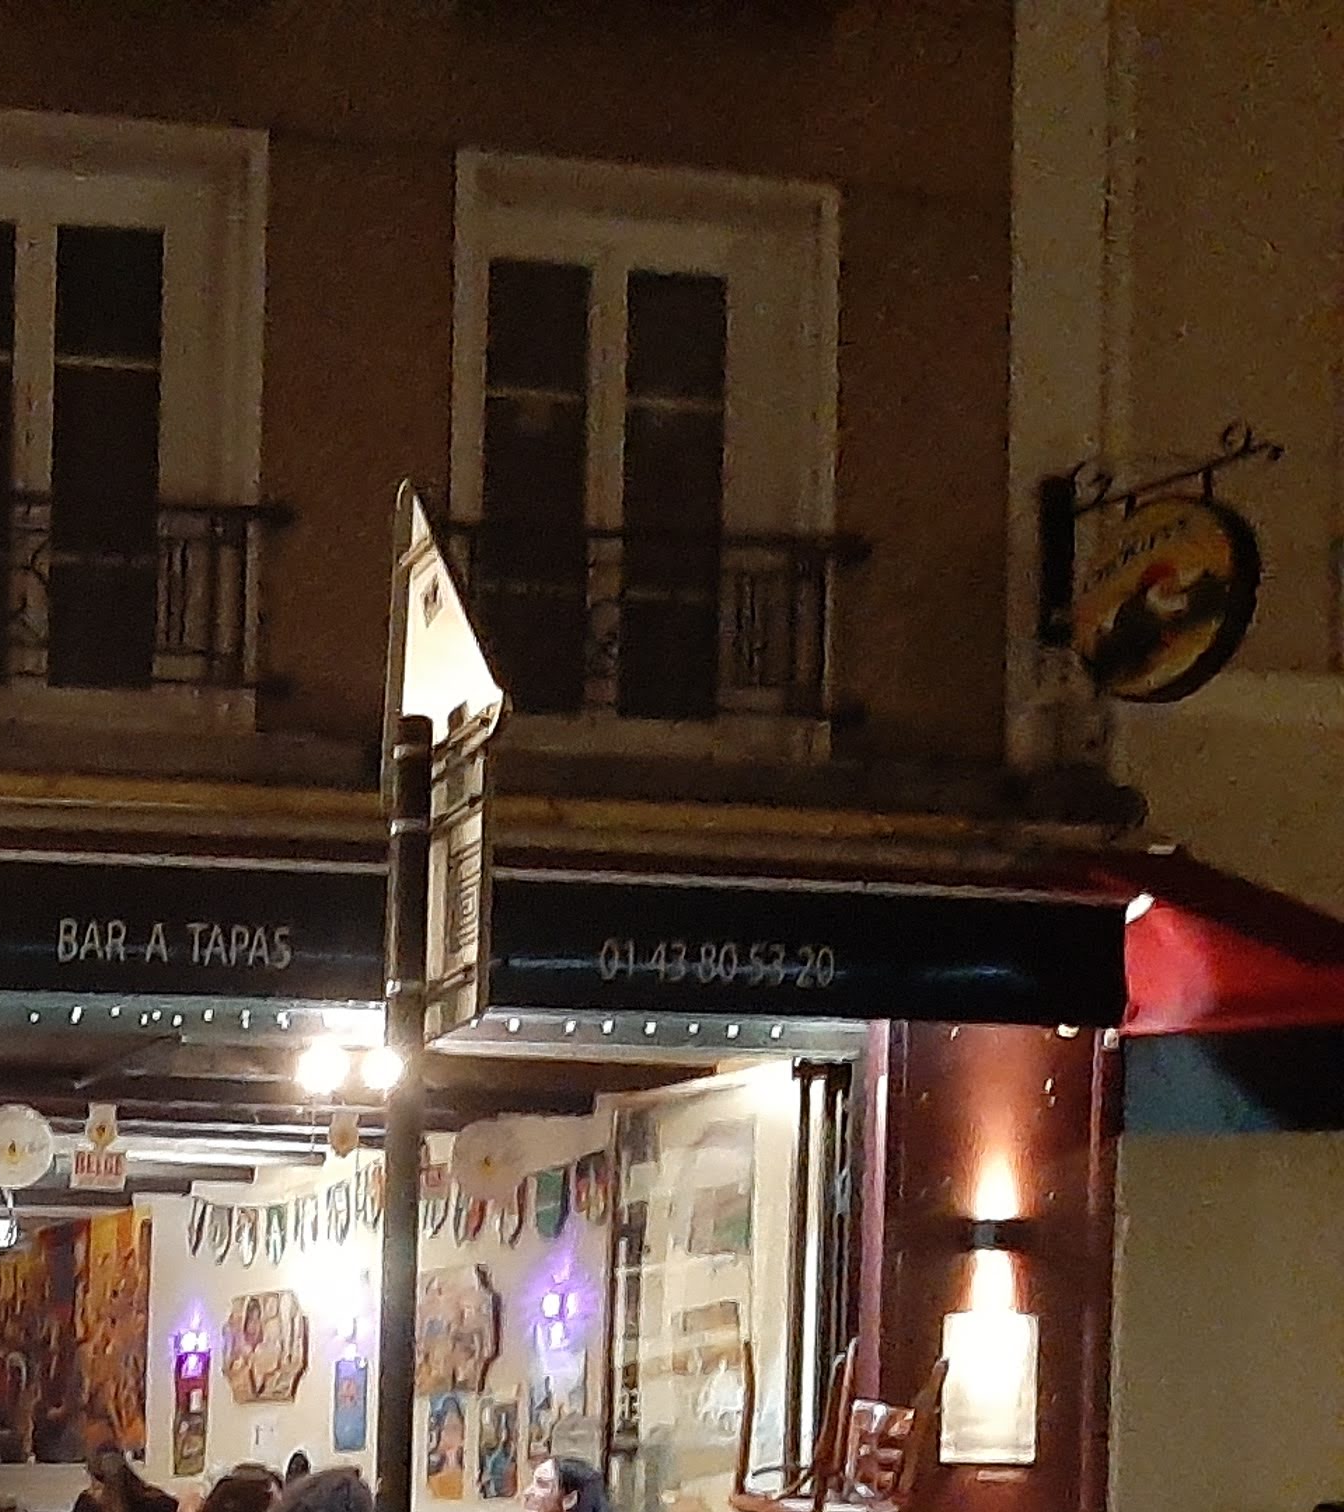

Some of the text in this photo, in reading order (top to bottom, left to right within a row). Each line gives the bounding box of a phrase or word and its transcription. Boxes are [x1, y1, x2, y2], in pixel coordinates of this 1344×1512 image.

[57, 917, 292, 970] BAR A TAPAS
[599, 937, 635, 981] 01
[650, 941, 686, 981] 43
[698, 941, 738, 983] 80
[796, 945, 835, 989] 20
